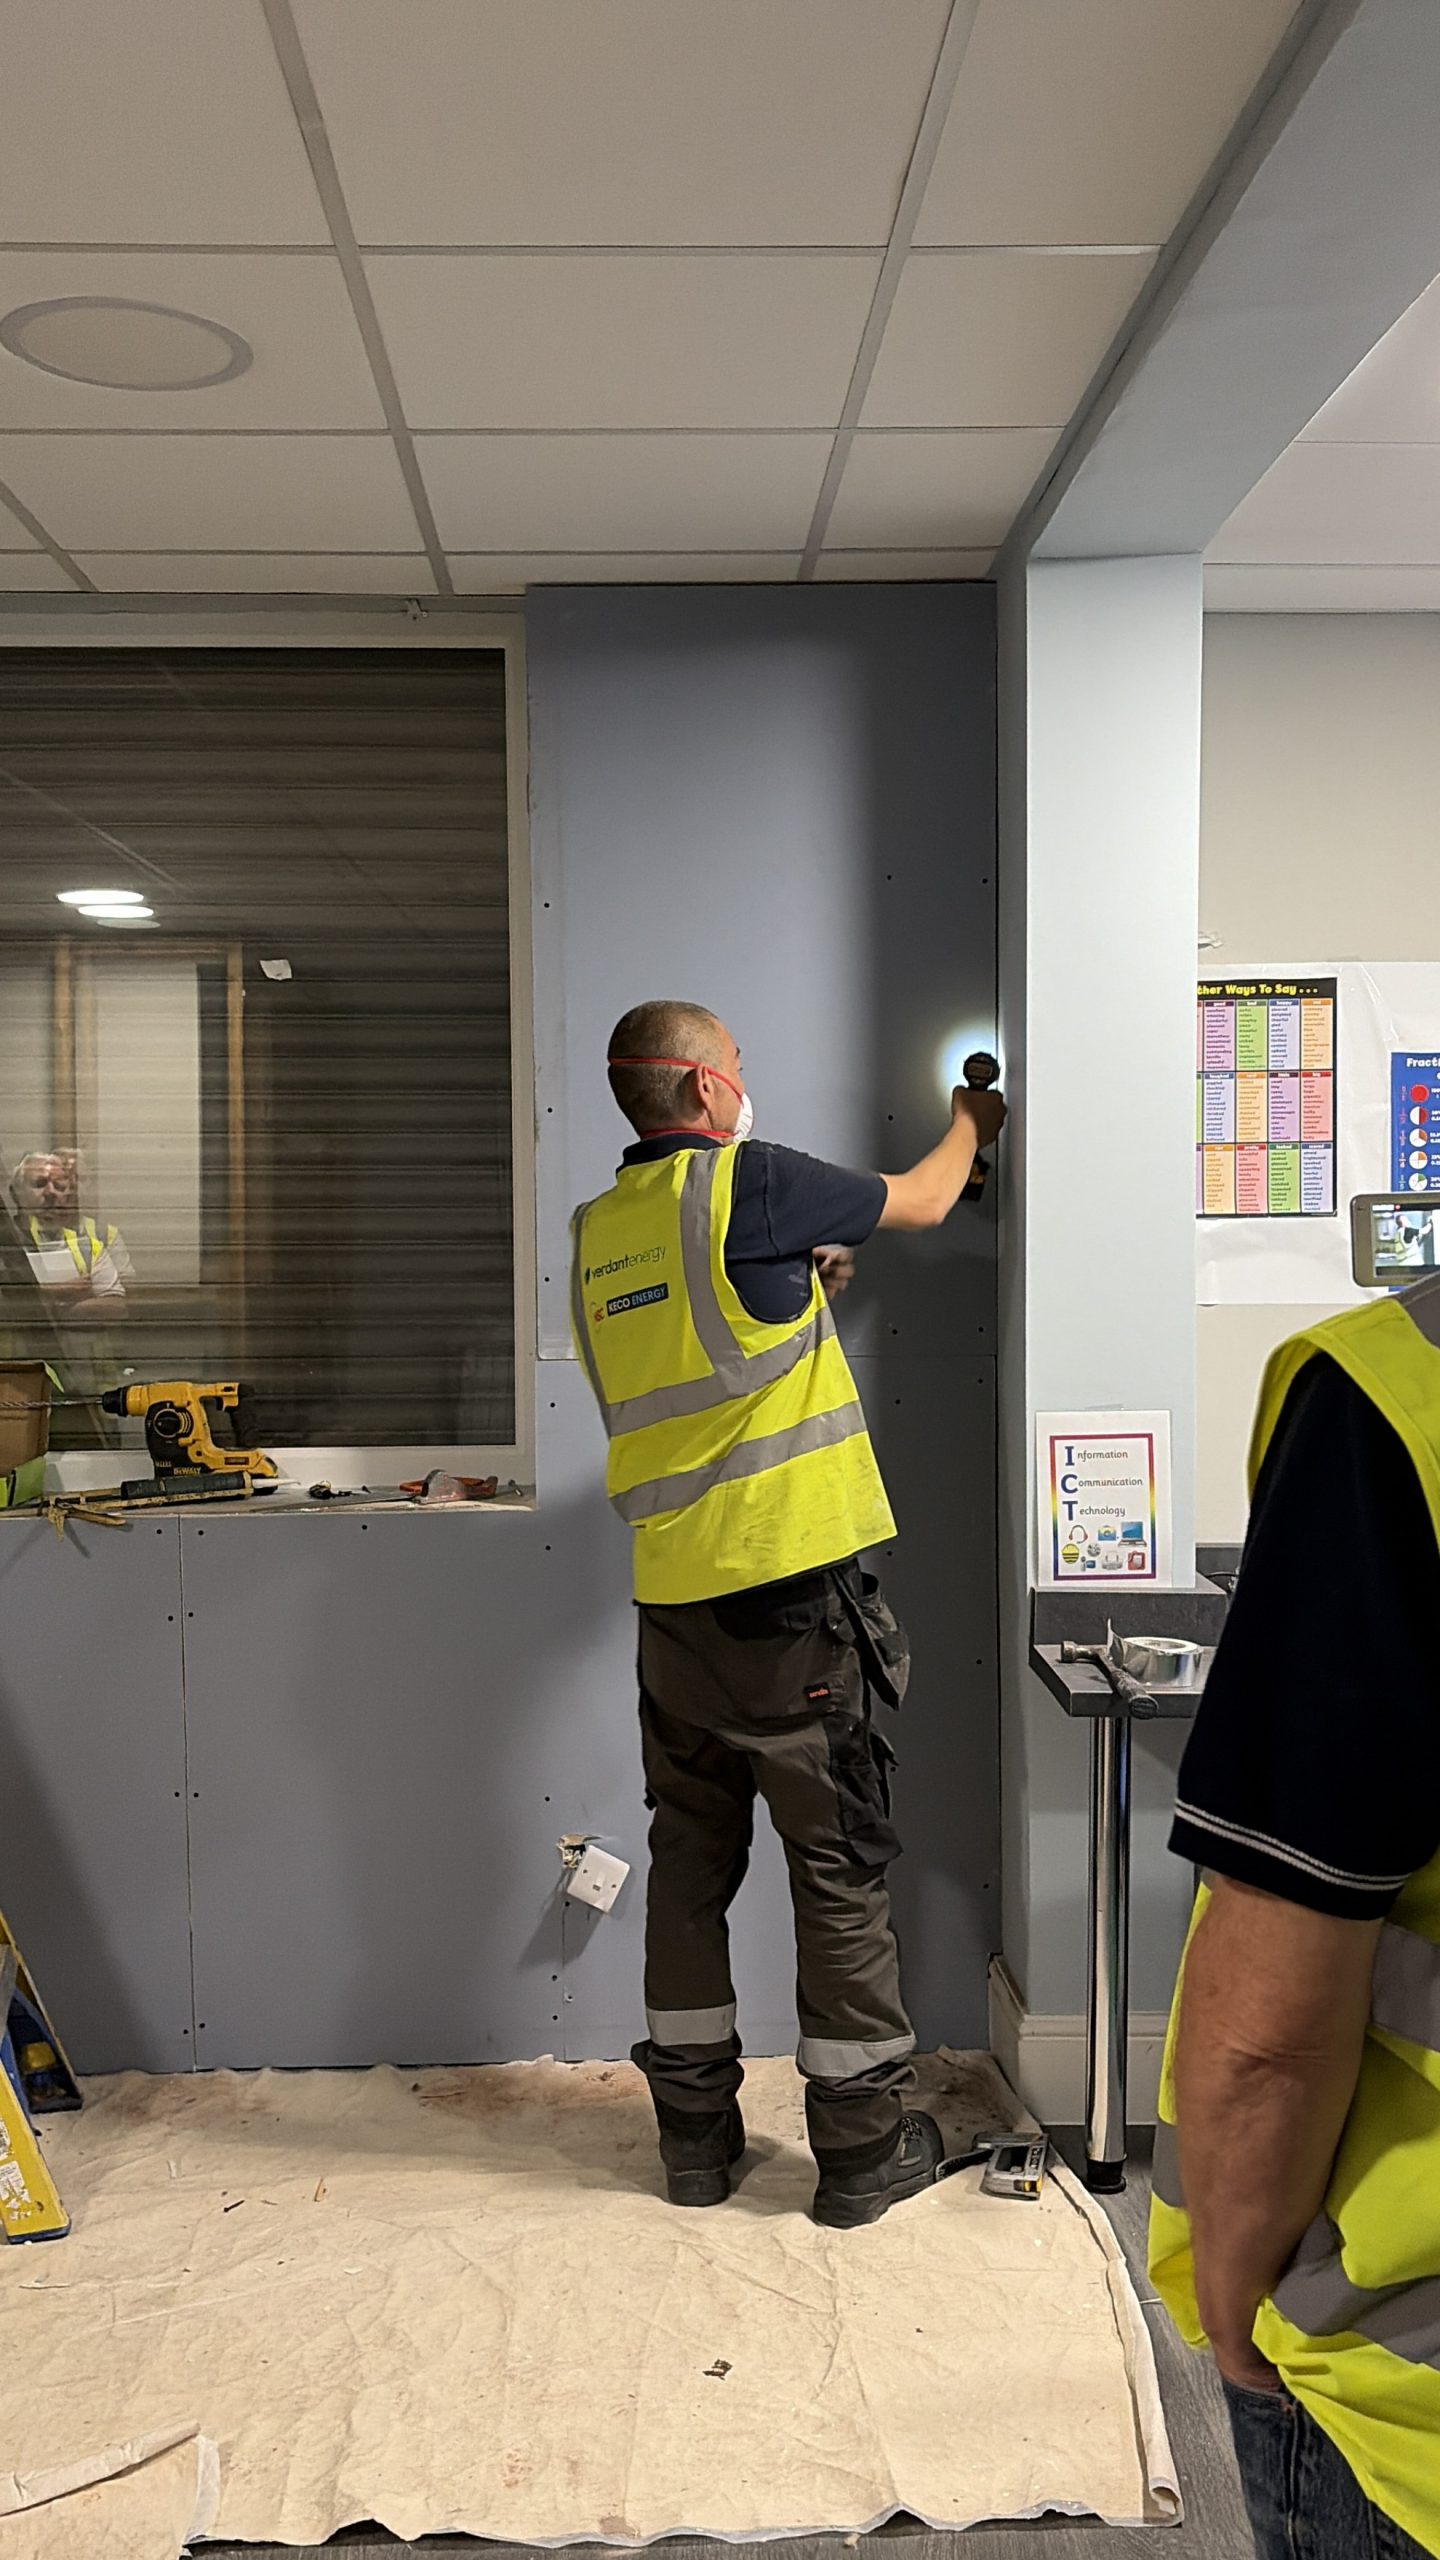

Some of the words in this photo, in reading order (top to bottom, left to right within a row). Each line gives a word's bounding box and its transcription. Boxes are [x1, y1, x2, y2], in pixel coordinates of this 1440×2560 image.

[1197, 984, 1223, 995] ther
[1225, 984, 1257, 997] Ways
[1259, 984, 1272, 994] To
[1275, 983, 1297, 996] Say
[592, 1246, 666, 1279] verdantenergy
[631, 1286, 666, 1306] ENERGY
